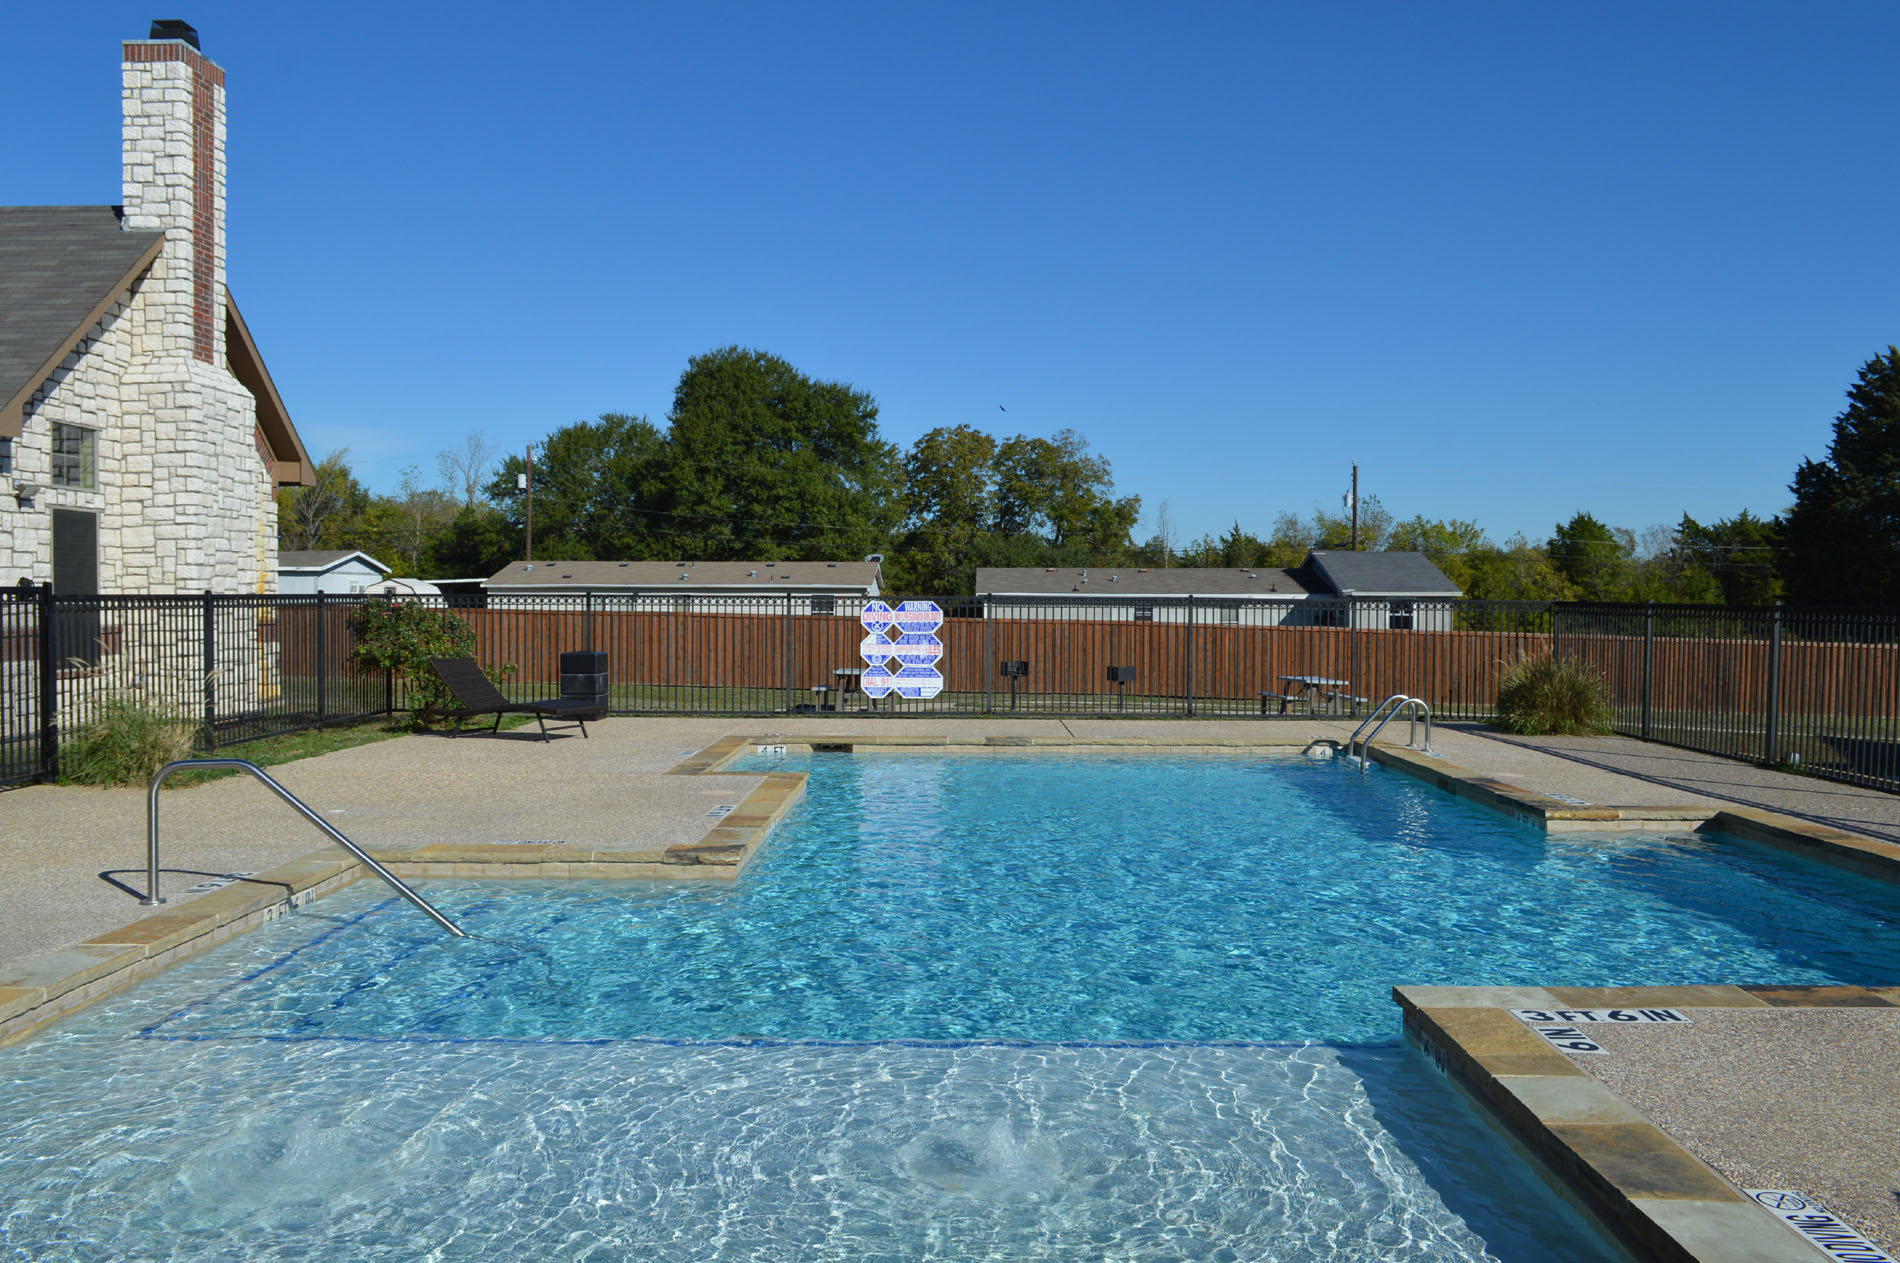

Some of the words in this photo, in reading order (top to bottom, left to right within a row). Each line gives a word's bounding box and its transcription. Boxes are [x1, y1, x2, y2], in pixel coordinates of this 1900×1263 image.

[871, 602, 884, 612] NO
[905, 602, 932, 612] WARNING
[862, 612, 893, 621] DIVING
[1520, 1010, 1556, 1022] 3
[1607, 1010, 1639, 1022] 6
[1785, 1215, 1876, 1252] DIVING
